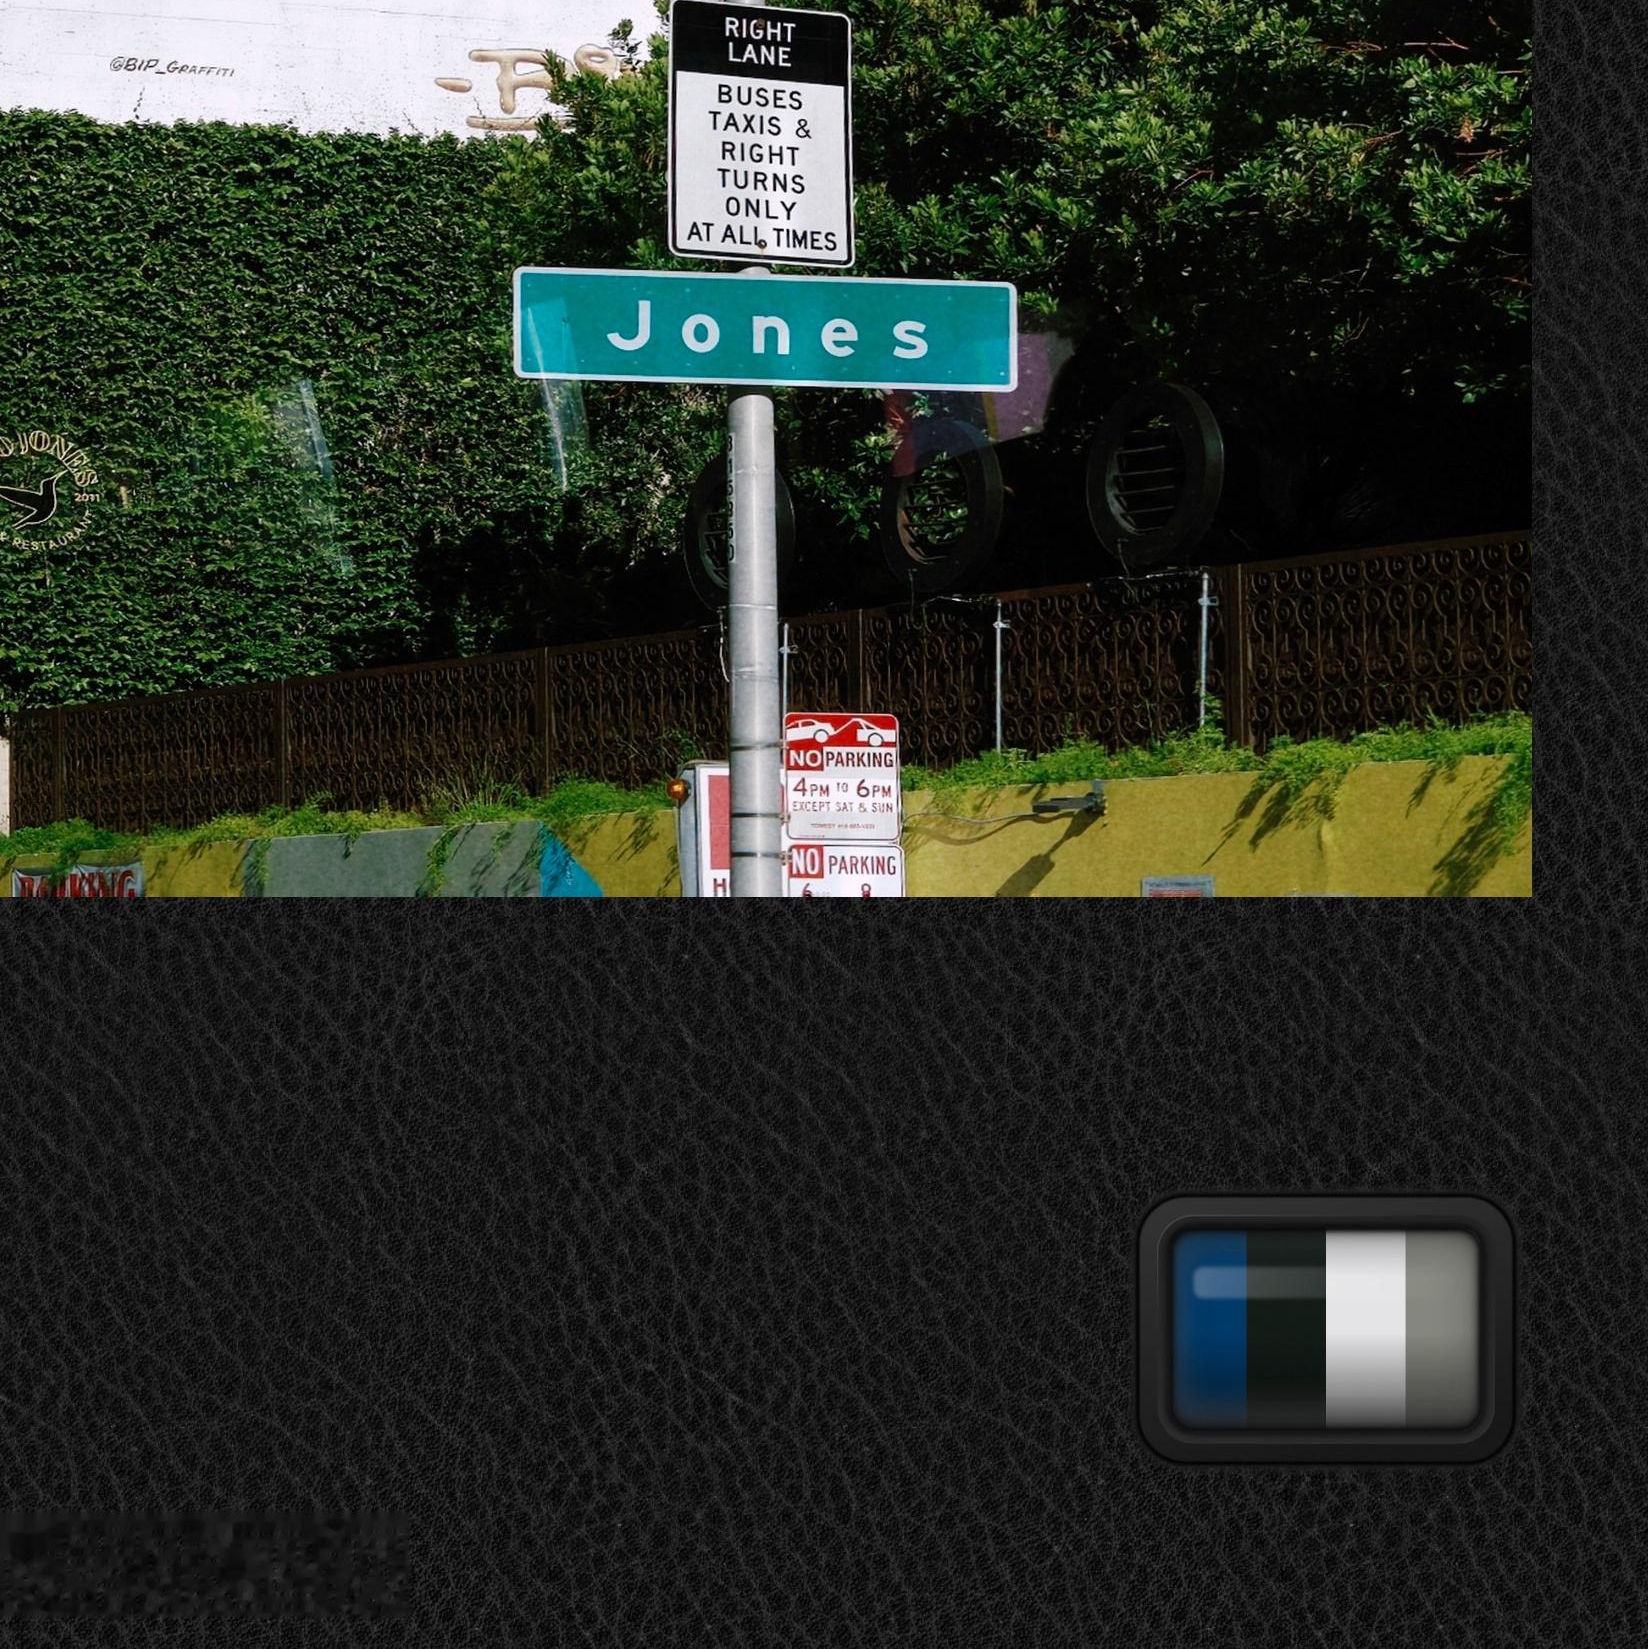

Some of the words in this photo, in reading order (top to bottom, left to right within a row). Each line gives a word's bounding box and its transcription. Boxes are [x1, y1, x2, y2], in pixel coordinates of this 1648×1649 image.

[725, 16, 796, 43] RIGHT
[728, 41, 792, 67] LANE
[718, 84, 803, 111] BUSES
[708, 110, 782, 136] TAXIS
[795, 118, 812, 139] &
[721, 141, 800, 166] RIGHT
[717, 168, 805, 194] TURNS
[725, 196, 797, 221] ONLY
[687, 221, 714, 242] AT
[721, 224, 764, 246] ALL
[773, 228, 837, 251] TIMES
[607, 300, 929, 360] Jones
[14, 429, 99, 488] JONES
[11, 509, 94, 551] RESTAURANT
[789, 749, 822, 767] NO
[825, 751, 893, 768] PARKING
[792, 777, 829, 798] 4PM
[836, 782, 849, 793] TO
[856, 778, 892, 798] 6PM
[792, 801, 831, 812] EXCEPT
[836, 802, 854, 813] SAT
[858, 803, 868, 813] &
[871, 803, 893, 813] SUN
[791, 847, 820, 875] NO
[828, 855, 896, 876] PARKING
